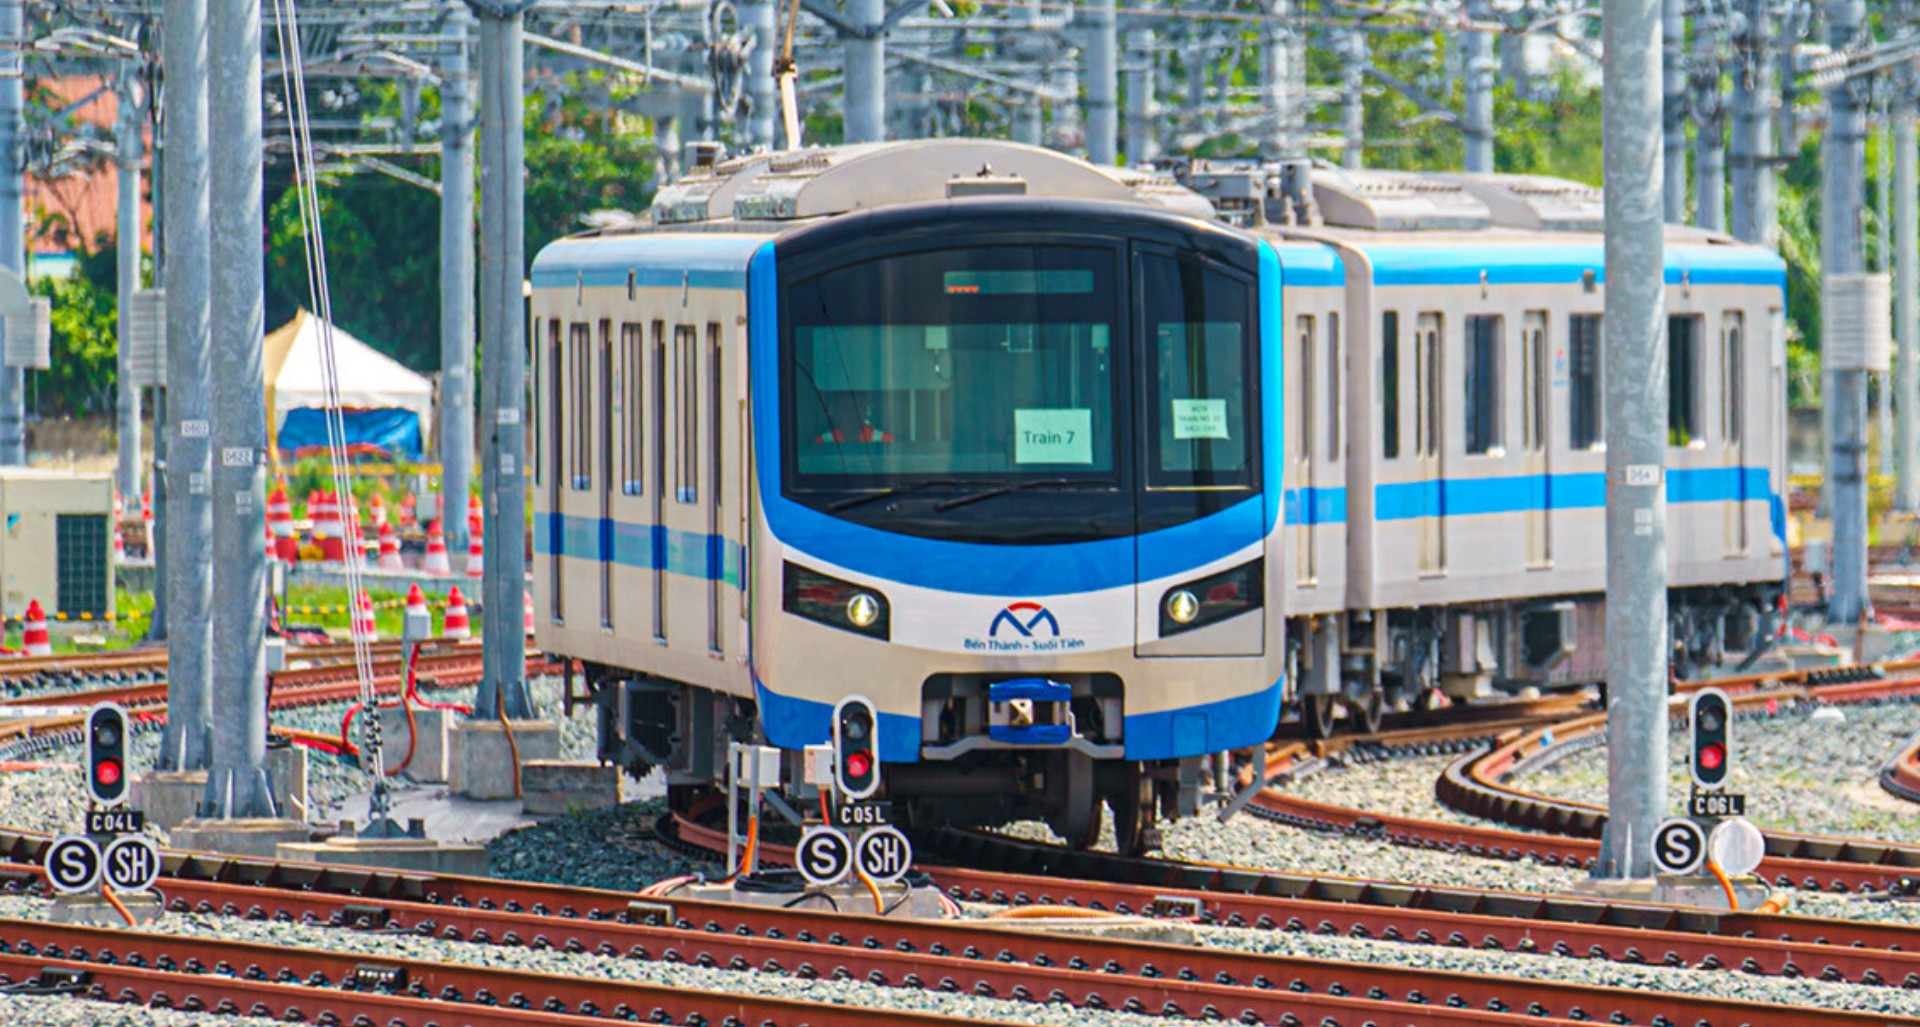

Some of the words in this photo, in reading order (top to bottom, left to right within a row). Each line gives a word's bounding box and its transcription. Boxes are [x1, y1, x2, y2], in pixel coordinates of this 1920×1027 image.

[1024, 430, 1061, 444] Train
[1066, 431, 1076, 444] 7
[92, 813, 137, 832] C04L
[842, 806, 886, 824] C05L
[1695, 797, 1740, 814] C06L
[60, 845, 87, 883] S
[115, 846, 147, 883] SH
[810, 837, 838, 874] S
[867, 837, 899, 874] SH
[1664, 828, 1692, 865] S
